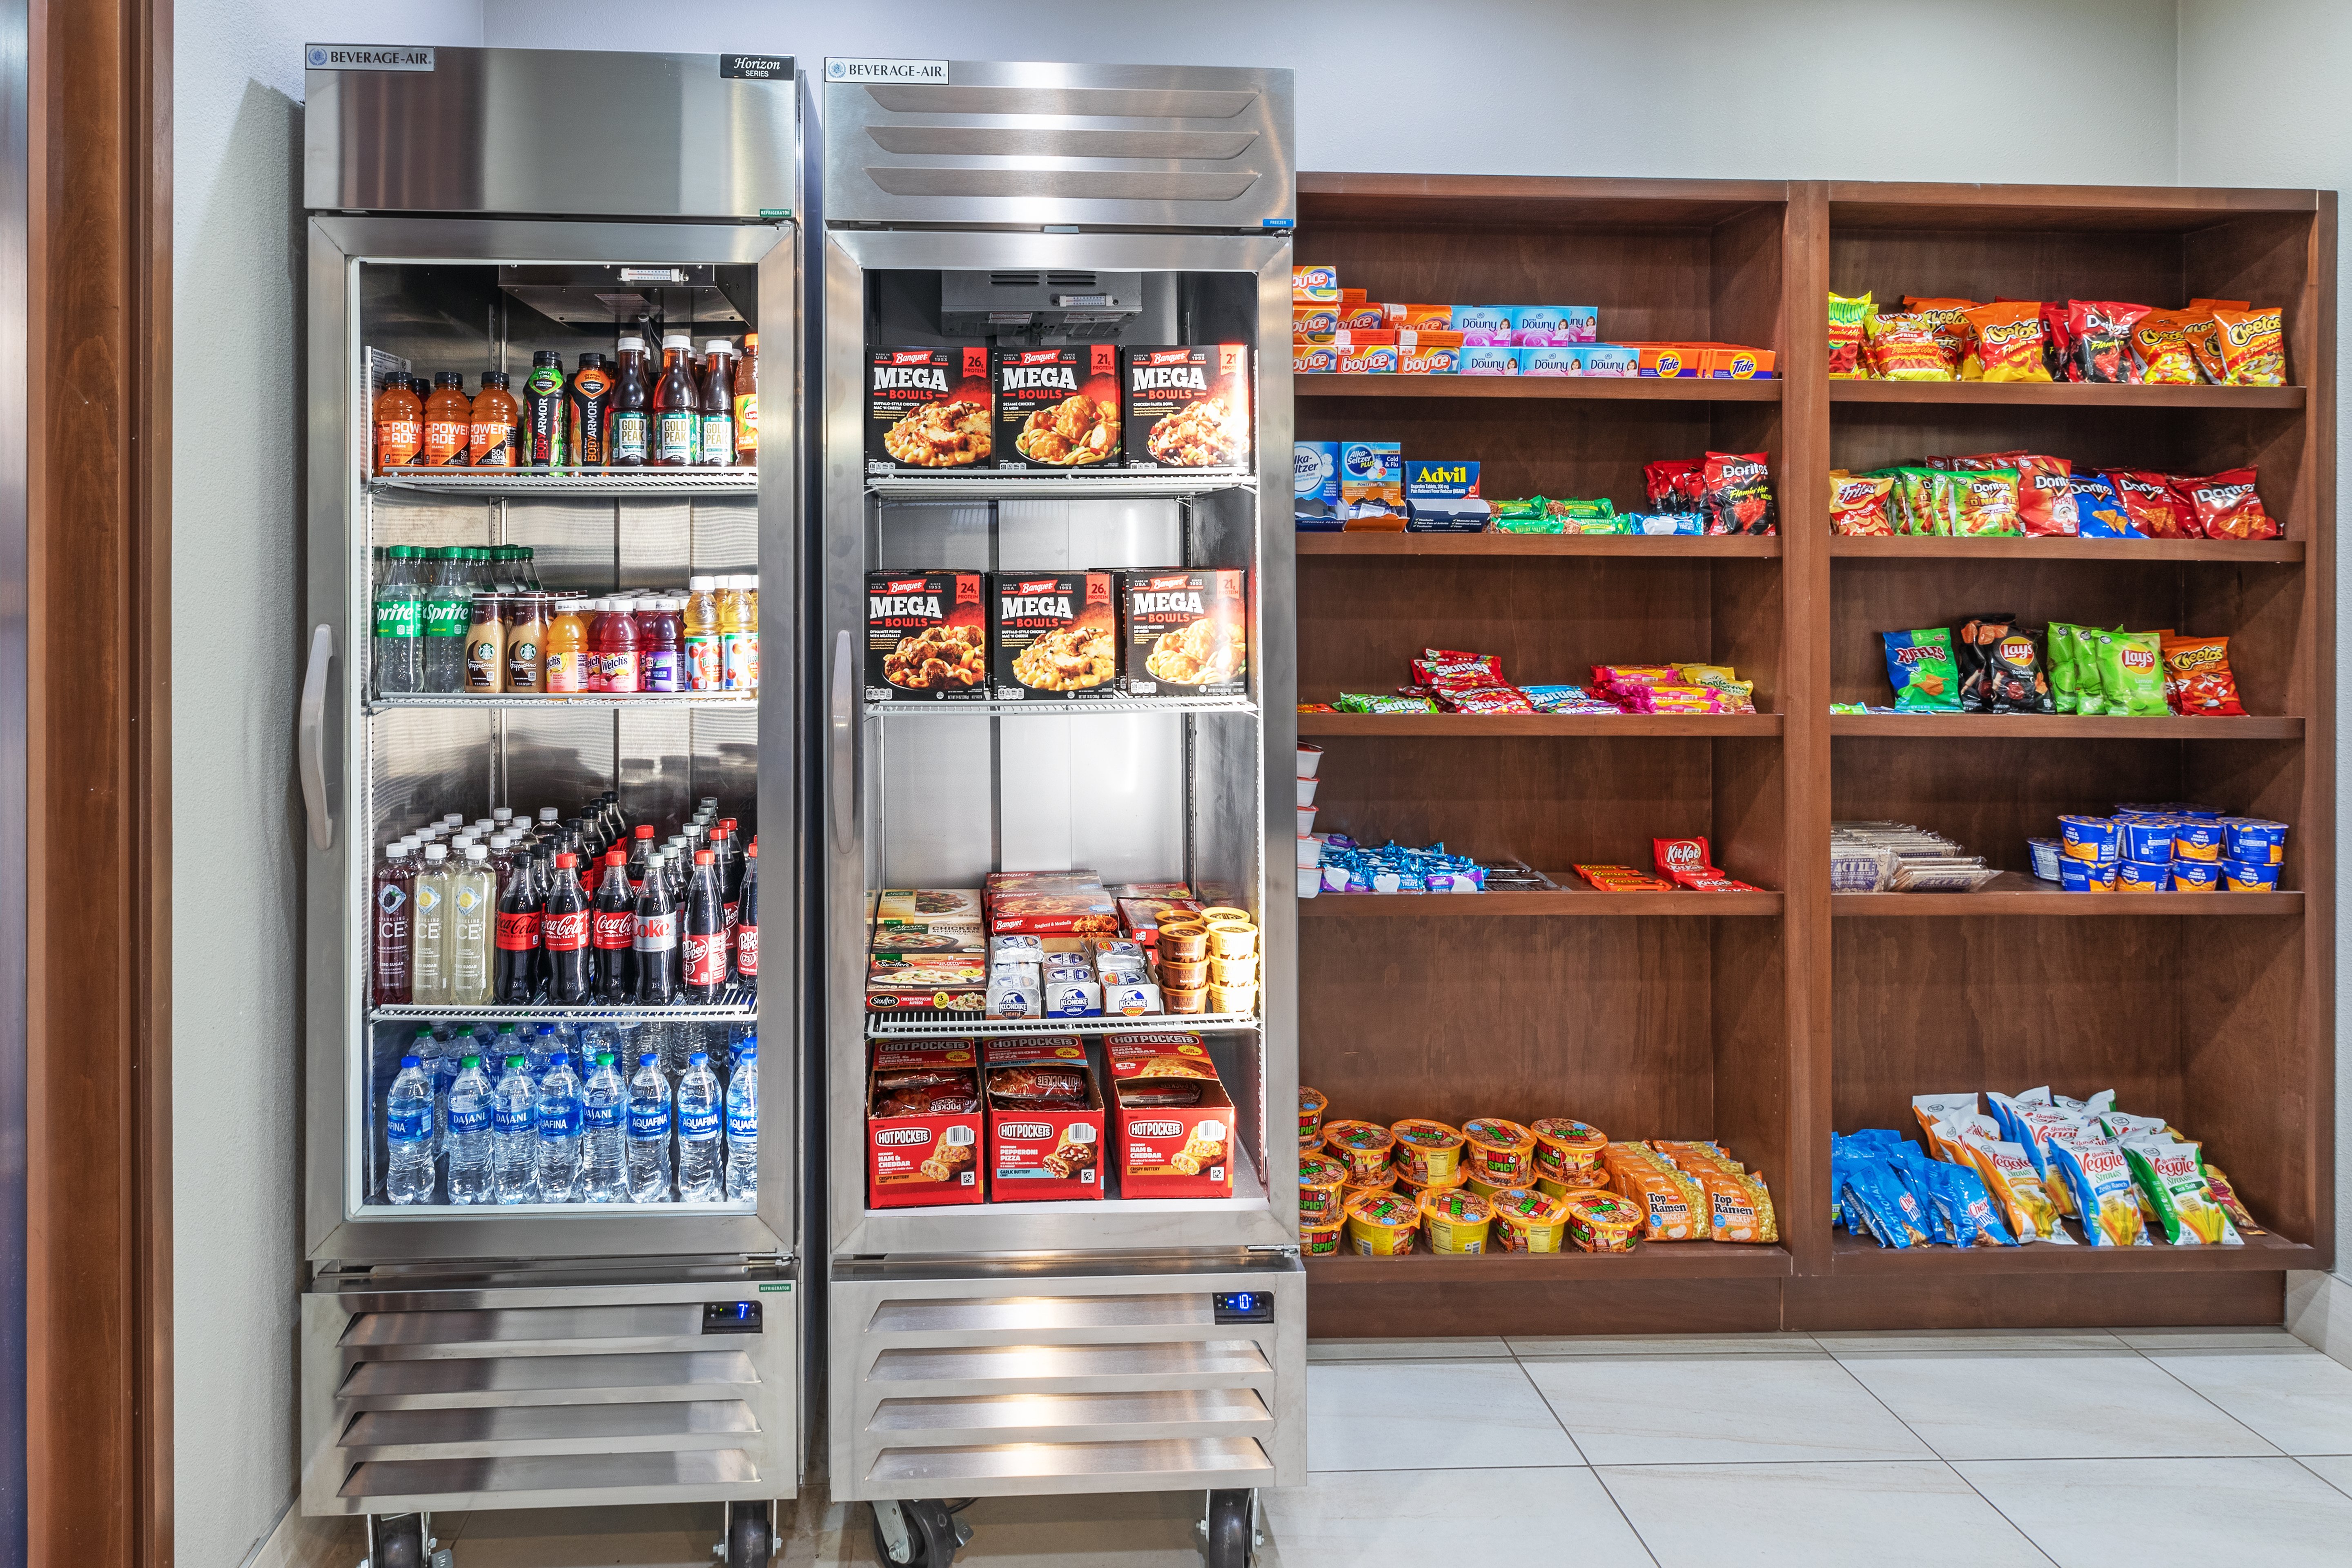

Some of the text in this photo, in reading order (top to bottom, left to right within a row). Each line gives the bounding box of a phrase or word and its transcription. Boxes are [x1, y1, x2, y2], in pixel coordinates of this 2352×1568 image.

[331, 51, 430, 65] BEVERAGE-AIR
[734, 57, 780, 70] Horizon
[849, 64, 942, 77] BEVERAGE-AIR
[1463, 318, 1497, 331] Downy
[1523, 319, 1555, 332] Downy
[2232, 316, 2281, 345] Cheetos
[895, 353, 928, 363] Banquet
[1024, 352, 1056, 363] Banquet
[1154, 352, 1185, 364] Banquet
[1343, 355, 1388, 373] bounce
[1404, 355, 1448, 373] bounce
[1472, 359, 1504, 371] Downy
[1535, 359, 1568, 372] Downy
[1659, 357, 1679, 374] Tide
[1733, 359, 1754, 376] Tide
[874, 367, 948, 392] MEGA
[1003, 368, 1077, 391] MEGA
[1133, 368, 1207, 391] MEGA
[889, 390, 933, 400] BOWLS
[1019, 390, 1062, 399] BOWLS
[1149, 390, 1192, 399] BOWLS
[432, 423, 470, 435] POWER
[536, 397, 548, 459] BODYARMOR
[588, 401, 597, 461] BODYARMOR
[622, 420, 644, 431] GOLD
[665, 420, 686, 431] GOLD
[392, 432, 416, 443] ADE
[622, 430, 644, 442] PEAK
[665, 430, 686, 442] PEAK
[1348, 455, 1372, 465] Seltzer
[1350, 450, 1368, 458] Alka-
[1417, 467, 1466, 483] Advil
[1723, 465, 1768, 477] Doritos
[1839, 483, 1876, 500] Fritos
[1974, 482, 2010, 492] Doritos
[891, 581, 922, 592] Banquet
[428, 603, 468, 623] Sprite
[870, 596, 942, 619] MEGA
[885, 618, 928, 627] BOWLS
[1895, 646, 1947, 664] RUFFLES
[2004, 642, 2033, 659] Lay's
[602, 657, 628, 670] Welch's
[2125, 650, 2154, 667] Lay's
[2171, 647, 2223, 668] Cheetos
[1435, 662, 1490, 676] Skittles
[1528, 690, 1586, 705] Skittles
[1834, 862, 1871, 872] ACT II
[379, 922, 405, 938] ICE
[633, 921, 670, 938] Coke
[686, 940, 697, 949] Dr
[999, 1002, 1027, 1012] KLONDIKE
[1060, 997, 1088, 1007] KLONDIKE
[1119, 999, 1147, 1009] KLONDIKE
[885, 1042, 965, 1051] HOT POCKETS
[993, 1038, 1074, 1048] HOT POCKETS
[453, 1112, 486, 1125] DASANI
[496, 1112, 527, 1125] DASANI
[632, 1114, 667, 1129] AQUAFINA
[683, 1114, 718, 1129] AQUAFINA
[878, 1129, 928, 1144] HOT POCKETS
[1001, 1125, 1050, 1137] HOT POCKETS
[1488, 1152, 1508, 1163] HOT
[1984, 1151, 2033, 1169] Veggie
[1488, 1161, 1516, 1172] SPICY
[2074, 1153, 2125, 1176] Veggie
[2098, 1185, 2110, 1194] Zesty
[1647, 1192, 1666, 1204] Top
[1713, 1193, 1732, 1205] Top
[1650, 1204, 1687, 1213] Ramen
[1715, 1203, 1753, 1215] Ramen
[1968, 1197, 1989, 1217] Chex
[1978, 1212, 1996, 1227] mix
